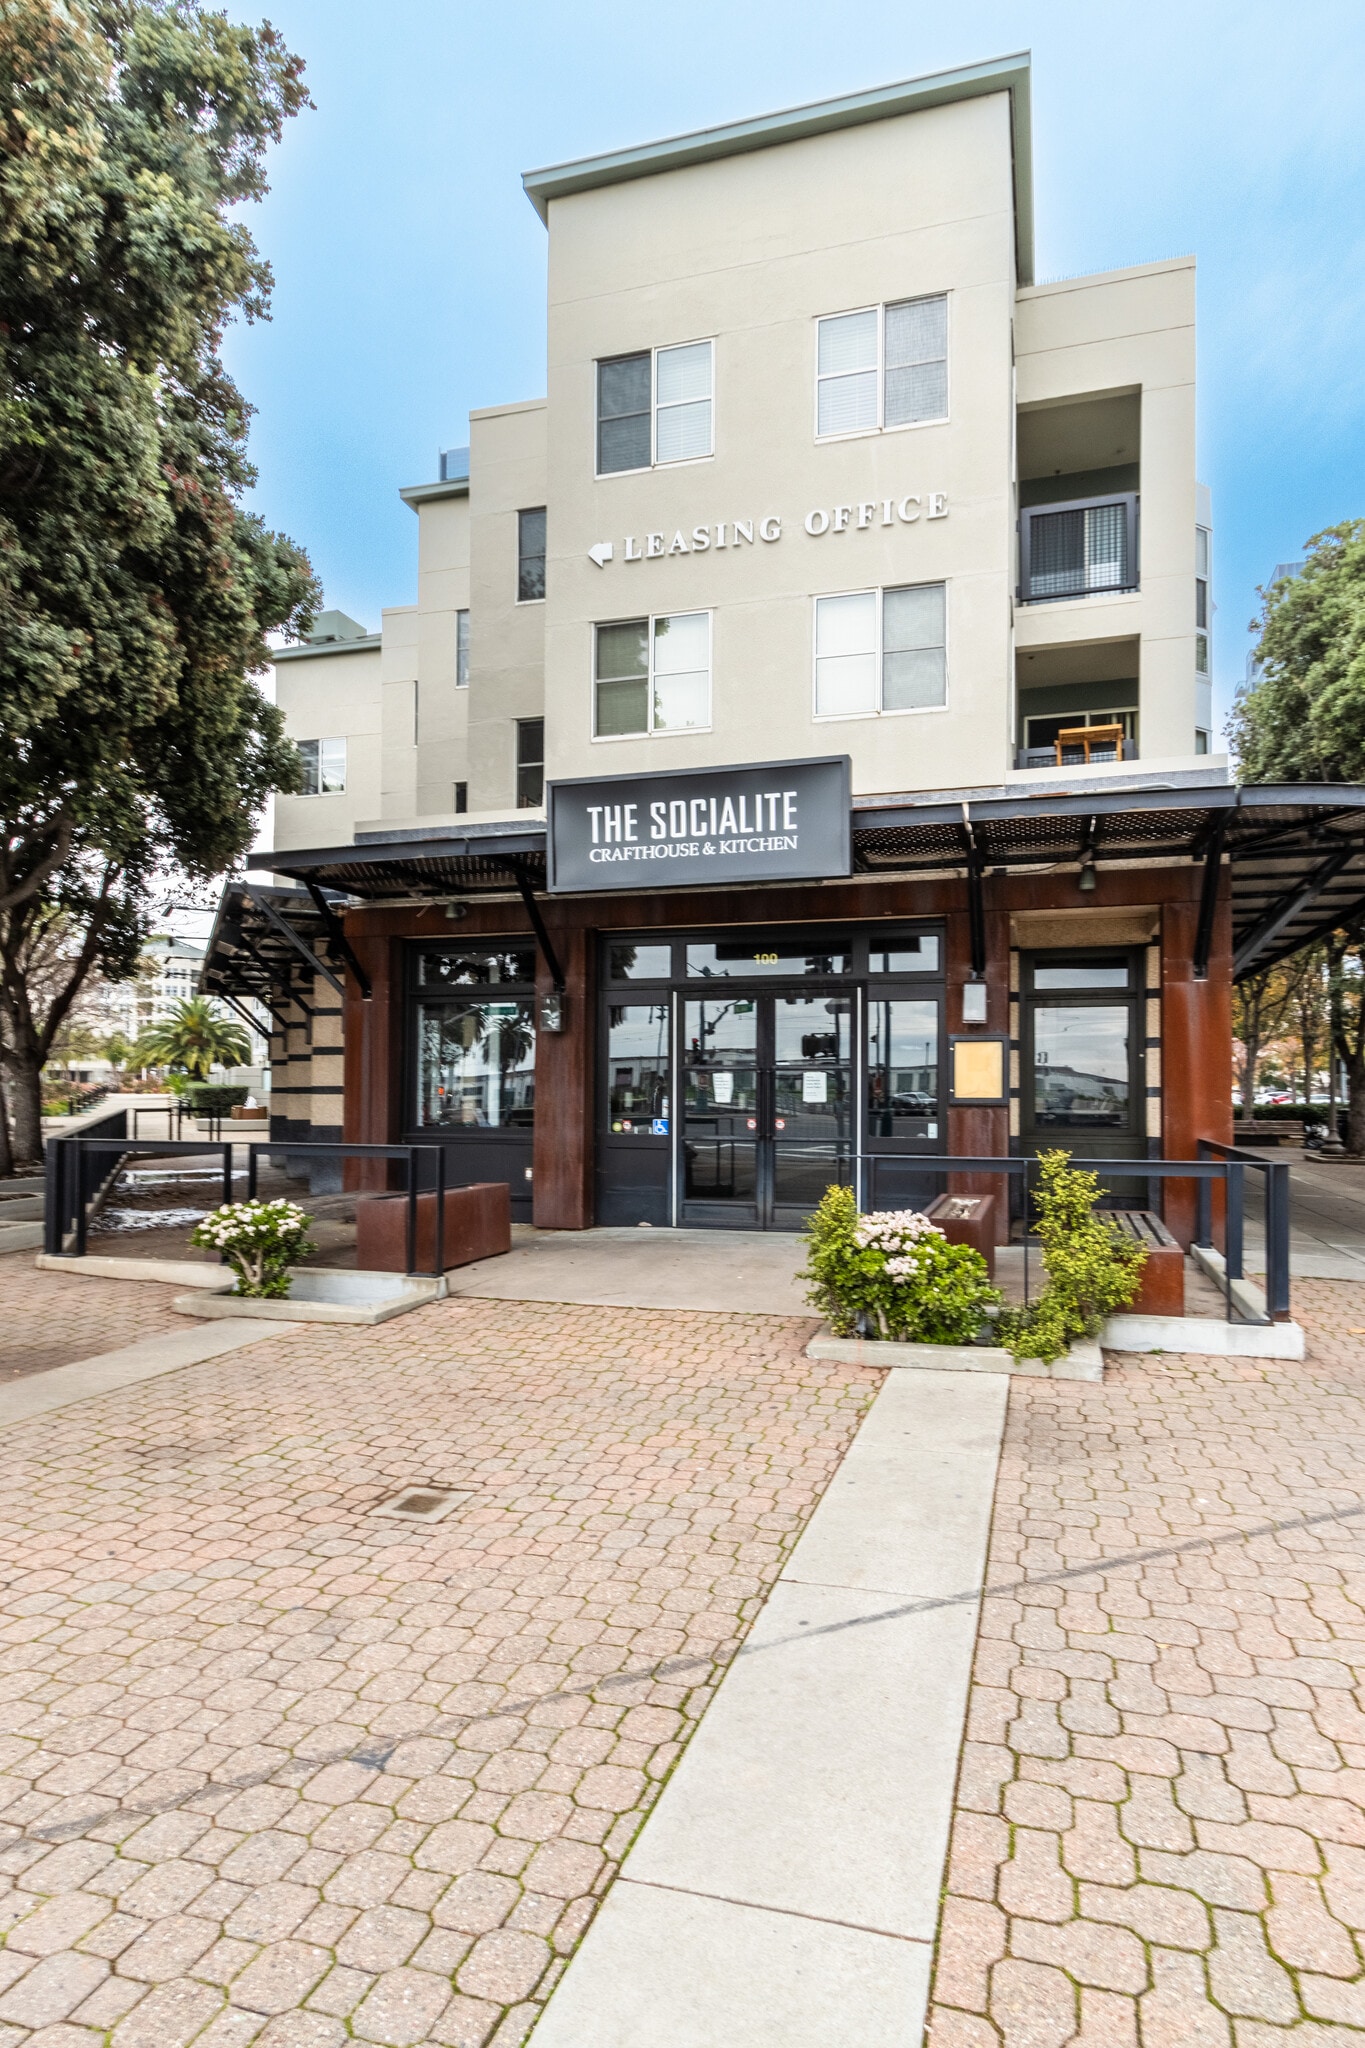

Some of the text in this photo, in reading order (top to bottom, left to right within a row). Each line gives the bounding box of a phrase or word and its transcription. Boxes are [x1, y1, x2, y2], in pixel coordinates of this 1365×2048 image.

[624, 492, 949, 562] LEASING OFFICE
[586, 791, 798, 844] THE SOCIALITE
[589, 835, 799, 863] CRAFTHOUSE & KITCHEN
[753, 953, 779, 965] 100
